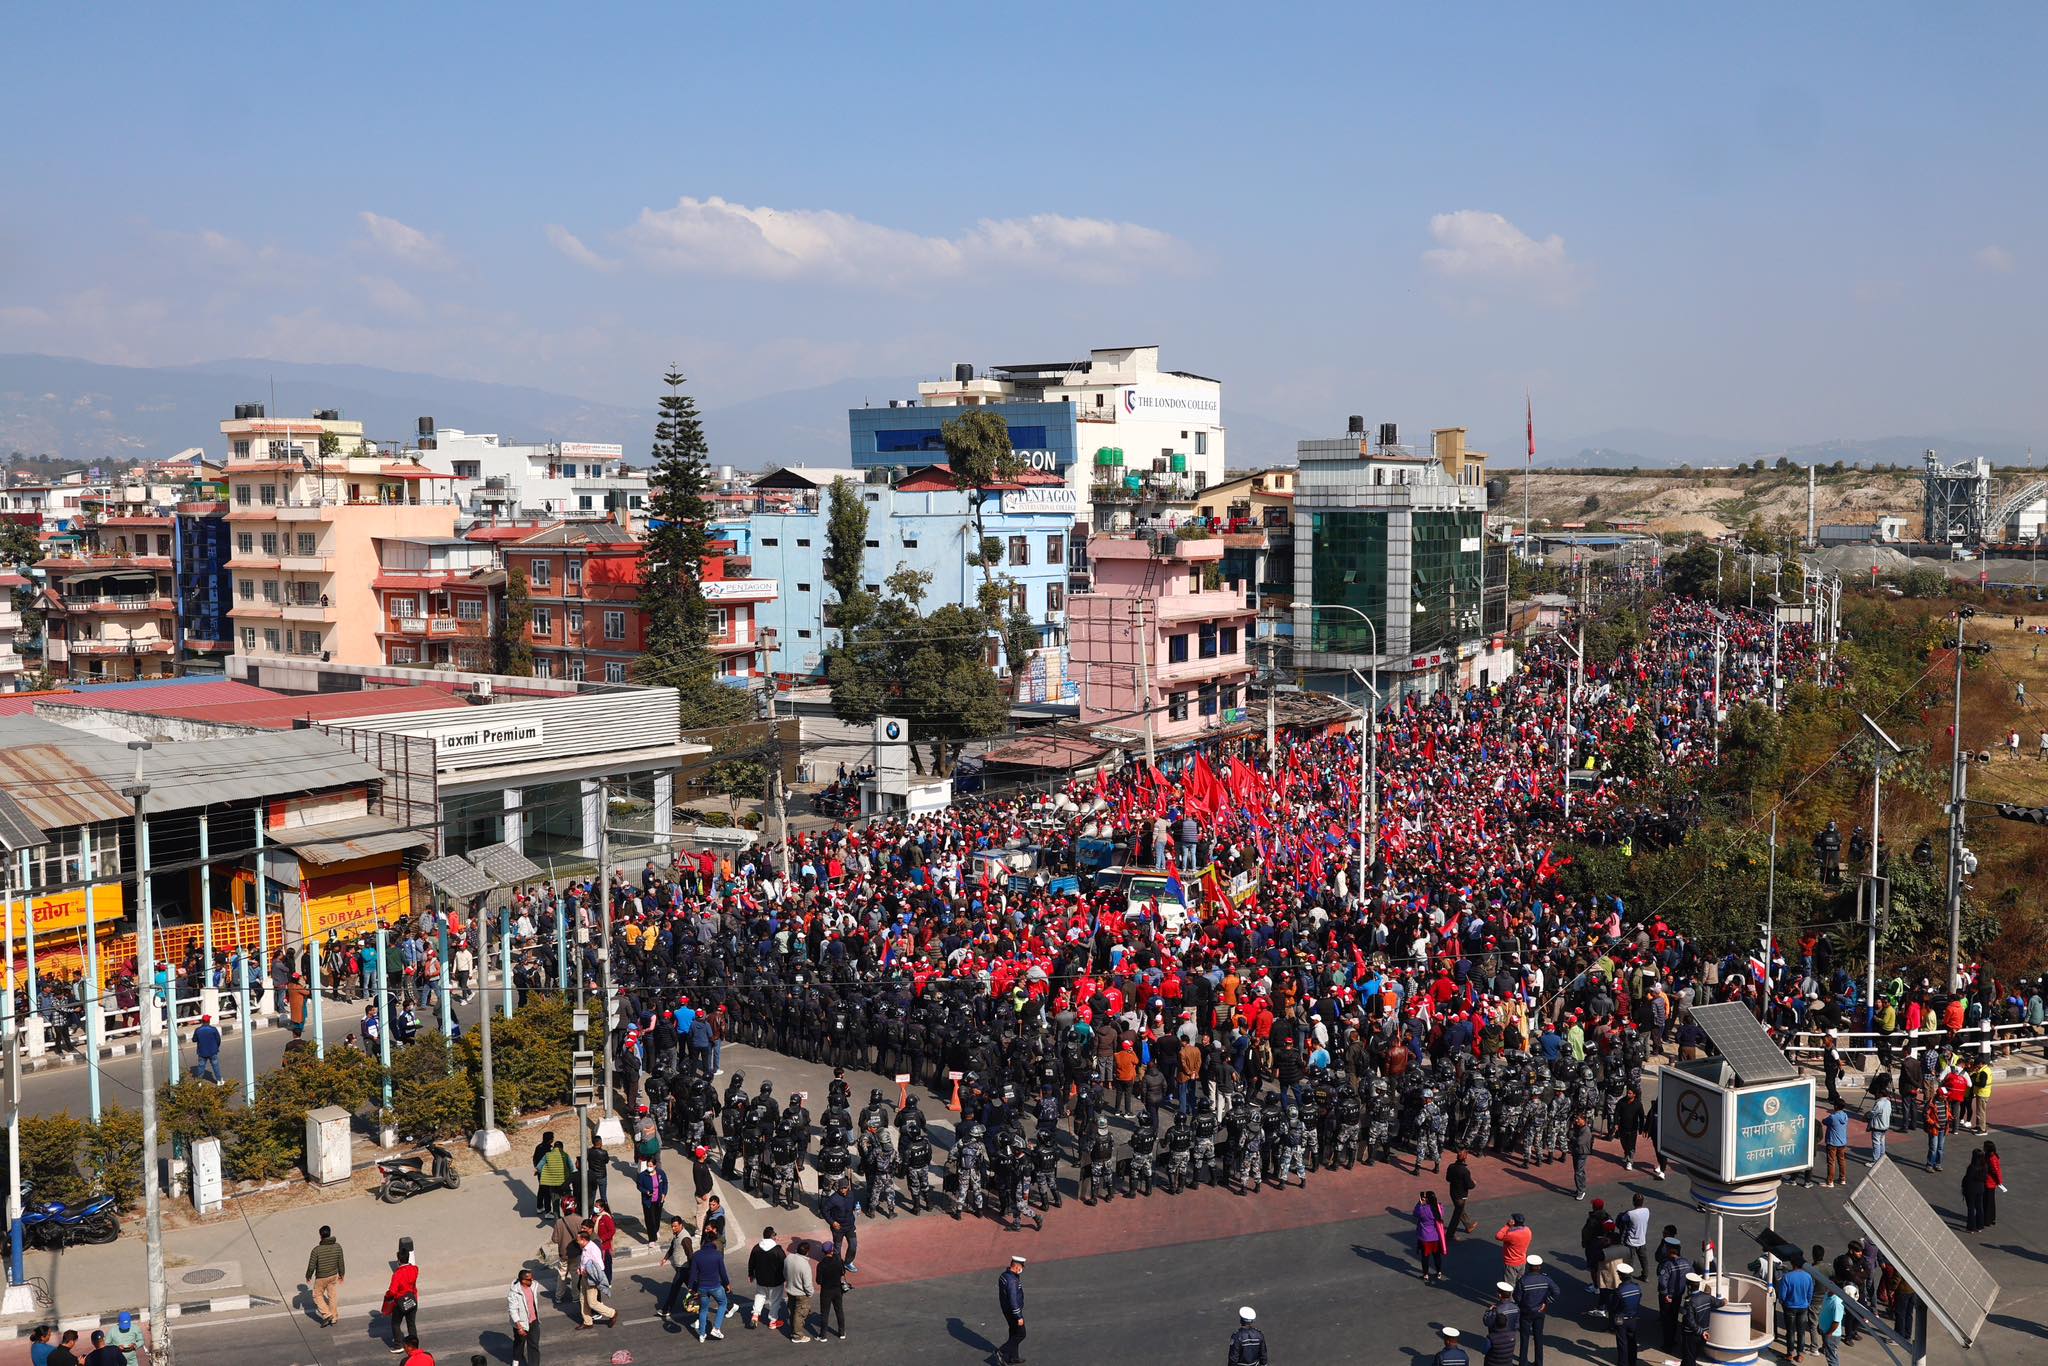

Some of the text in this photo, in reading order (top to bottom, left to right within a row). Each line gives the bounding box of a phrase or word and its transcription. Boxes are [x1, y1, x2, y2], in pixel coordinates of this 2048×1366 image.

[1138, 397, 1217, 411] THE LONDON COLLEGE
[1017, 489, 1077, 503] PENTAGON
[726, 583, 772, 592] PENTAGON
[442, 726, 536, 748] Laxmi Premium
[319, 909, 362, 926] SURYA
[1741, 1119, 1785, 1139] सामाजिक
[1746, 1147, 1775, 1161] कायम
